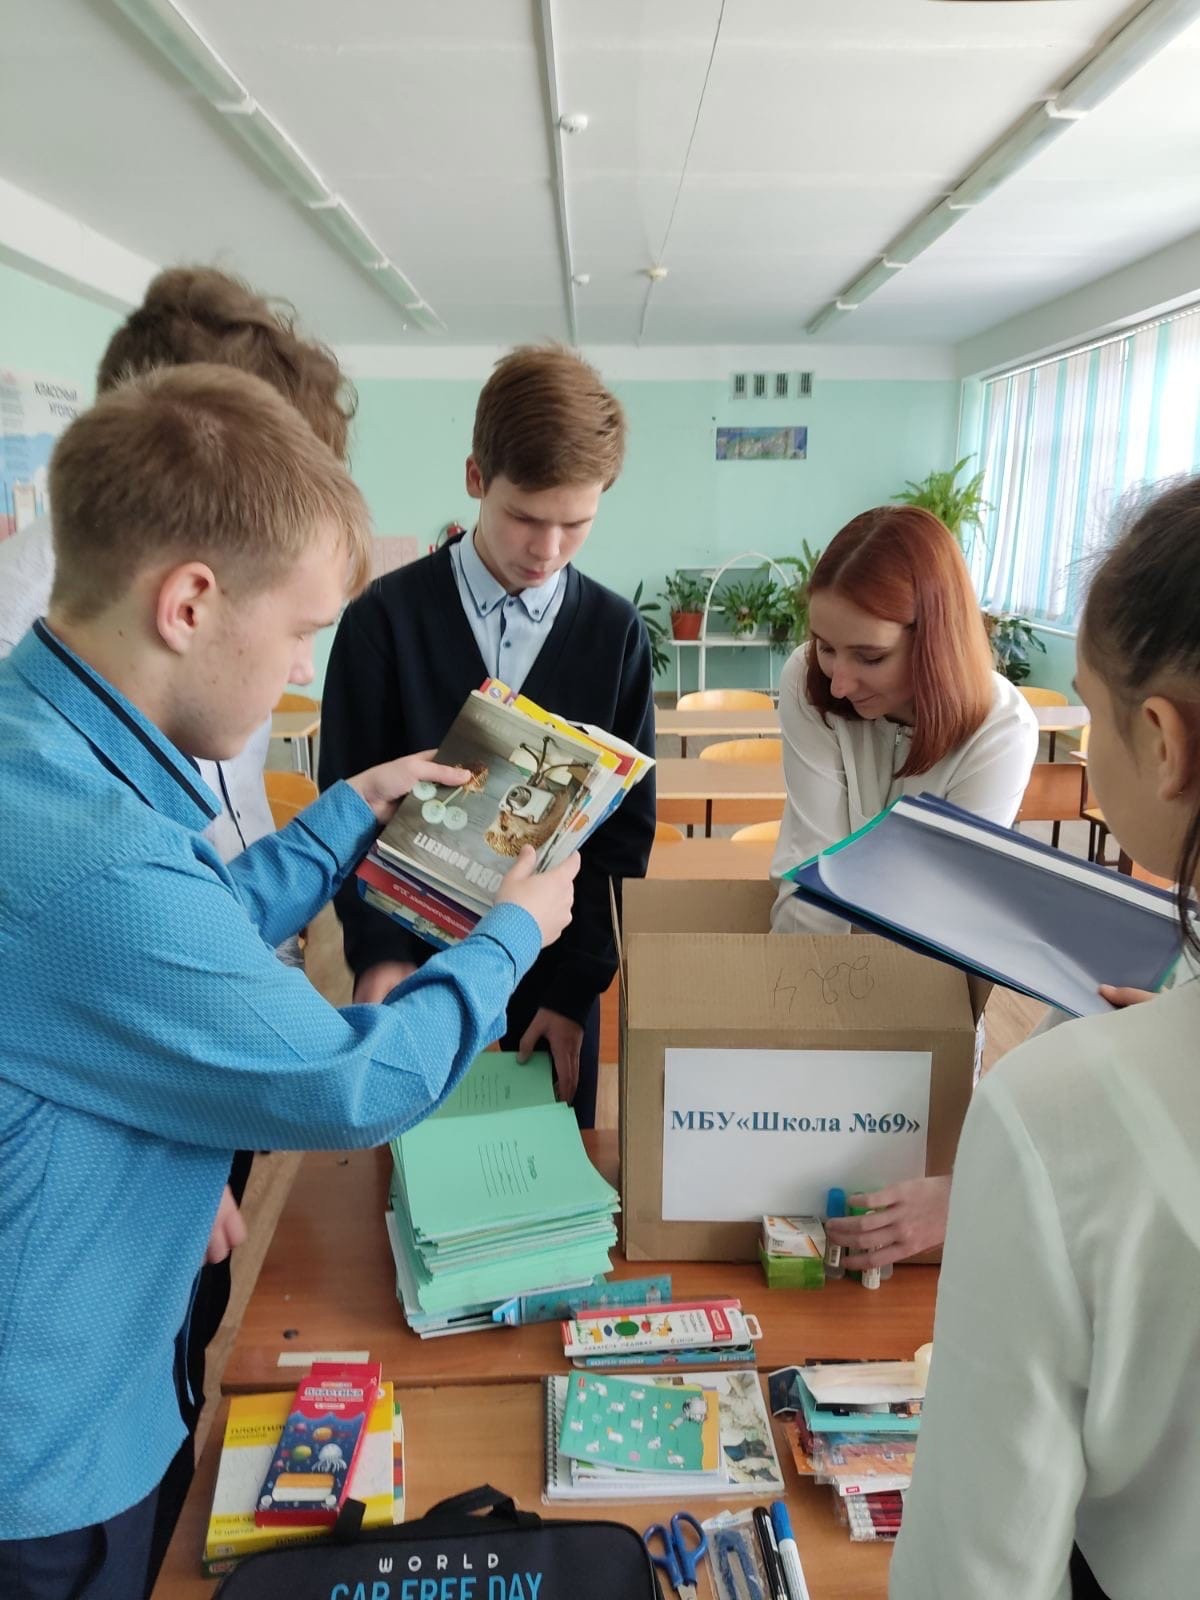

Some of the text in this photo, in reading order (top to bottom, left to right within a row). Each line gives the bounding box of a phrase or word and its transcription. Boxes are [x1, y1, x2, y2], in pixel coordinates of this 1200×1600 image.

[464, 861, 504, 893] ОВИ
[670, 1110, 921, 1134] МБУ«Школа №69»
[378, 1553, 499, 1574] WORLD
[401, 1576, 477, 1600] FREE
[488, 1572, 543, 1600] DAY
